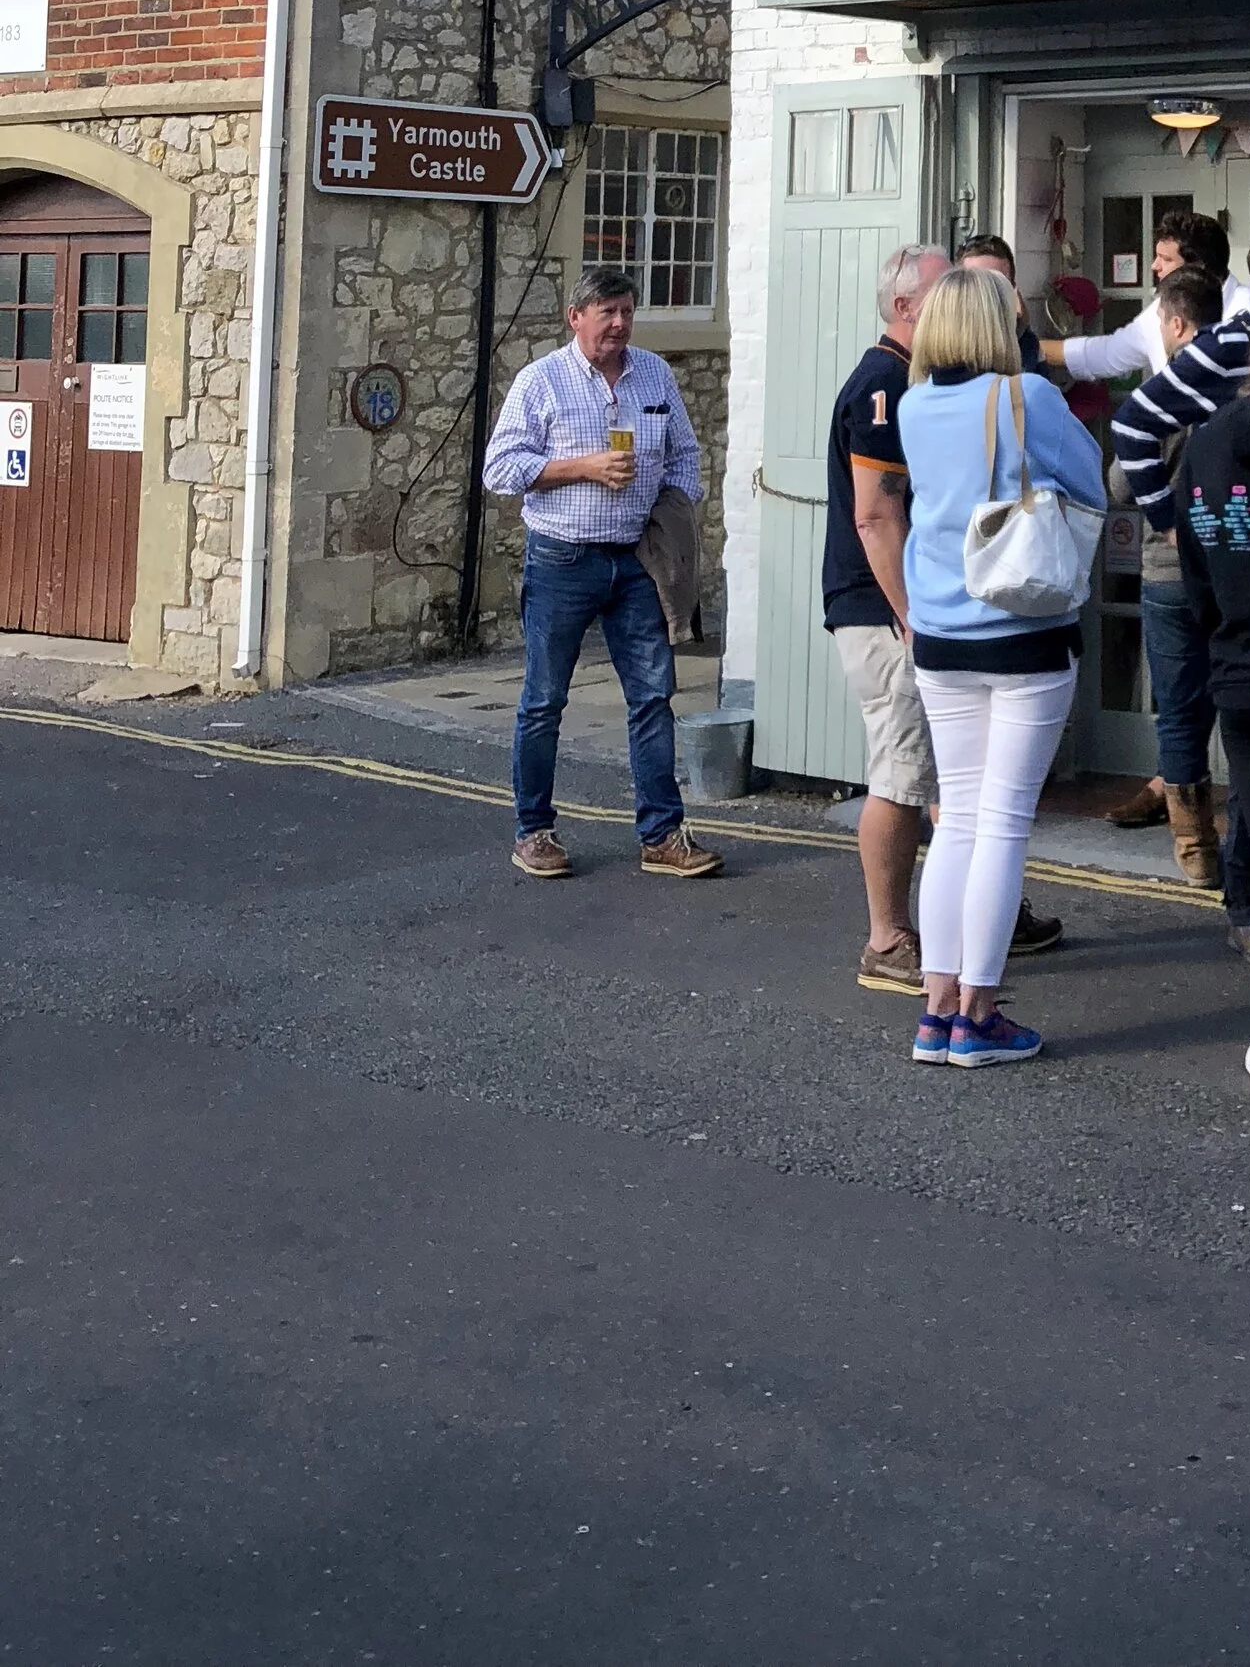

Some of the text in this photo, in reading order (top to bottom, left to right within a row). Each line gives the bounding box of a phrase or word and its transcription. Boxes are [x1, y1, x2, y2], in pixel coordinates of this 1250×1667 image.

[388, 117, 501, 152] Yarmouth
[409, 152, 486, 183] Castle
[871, 390, 888, 425] 1
